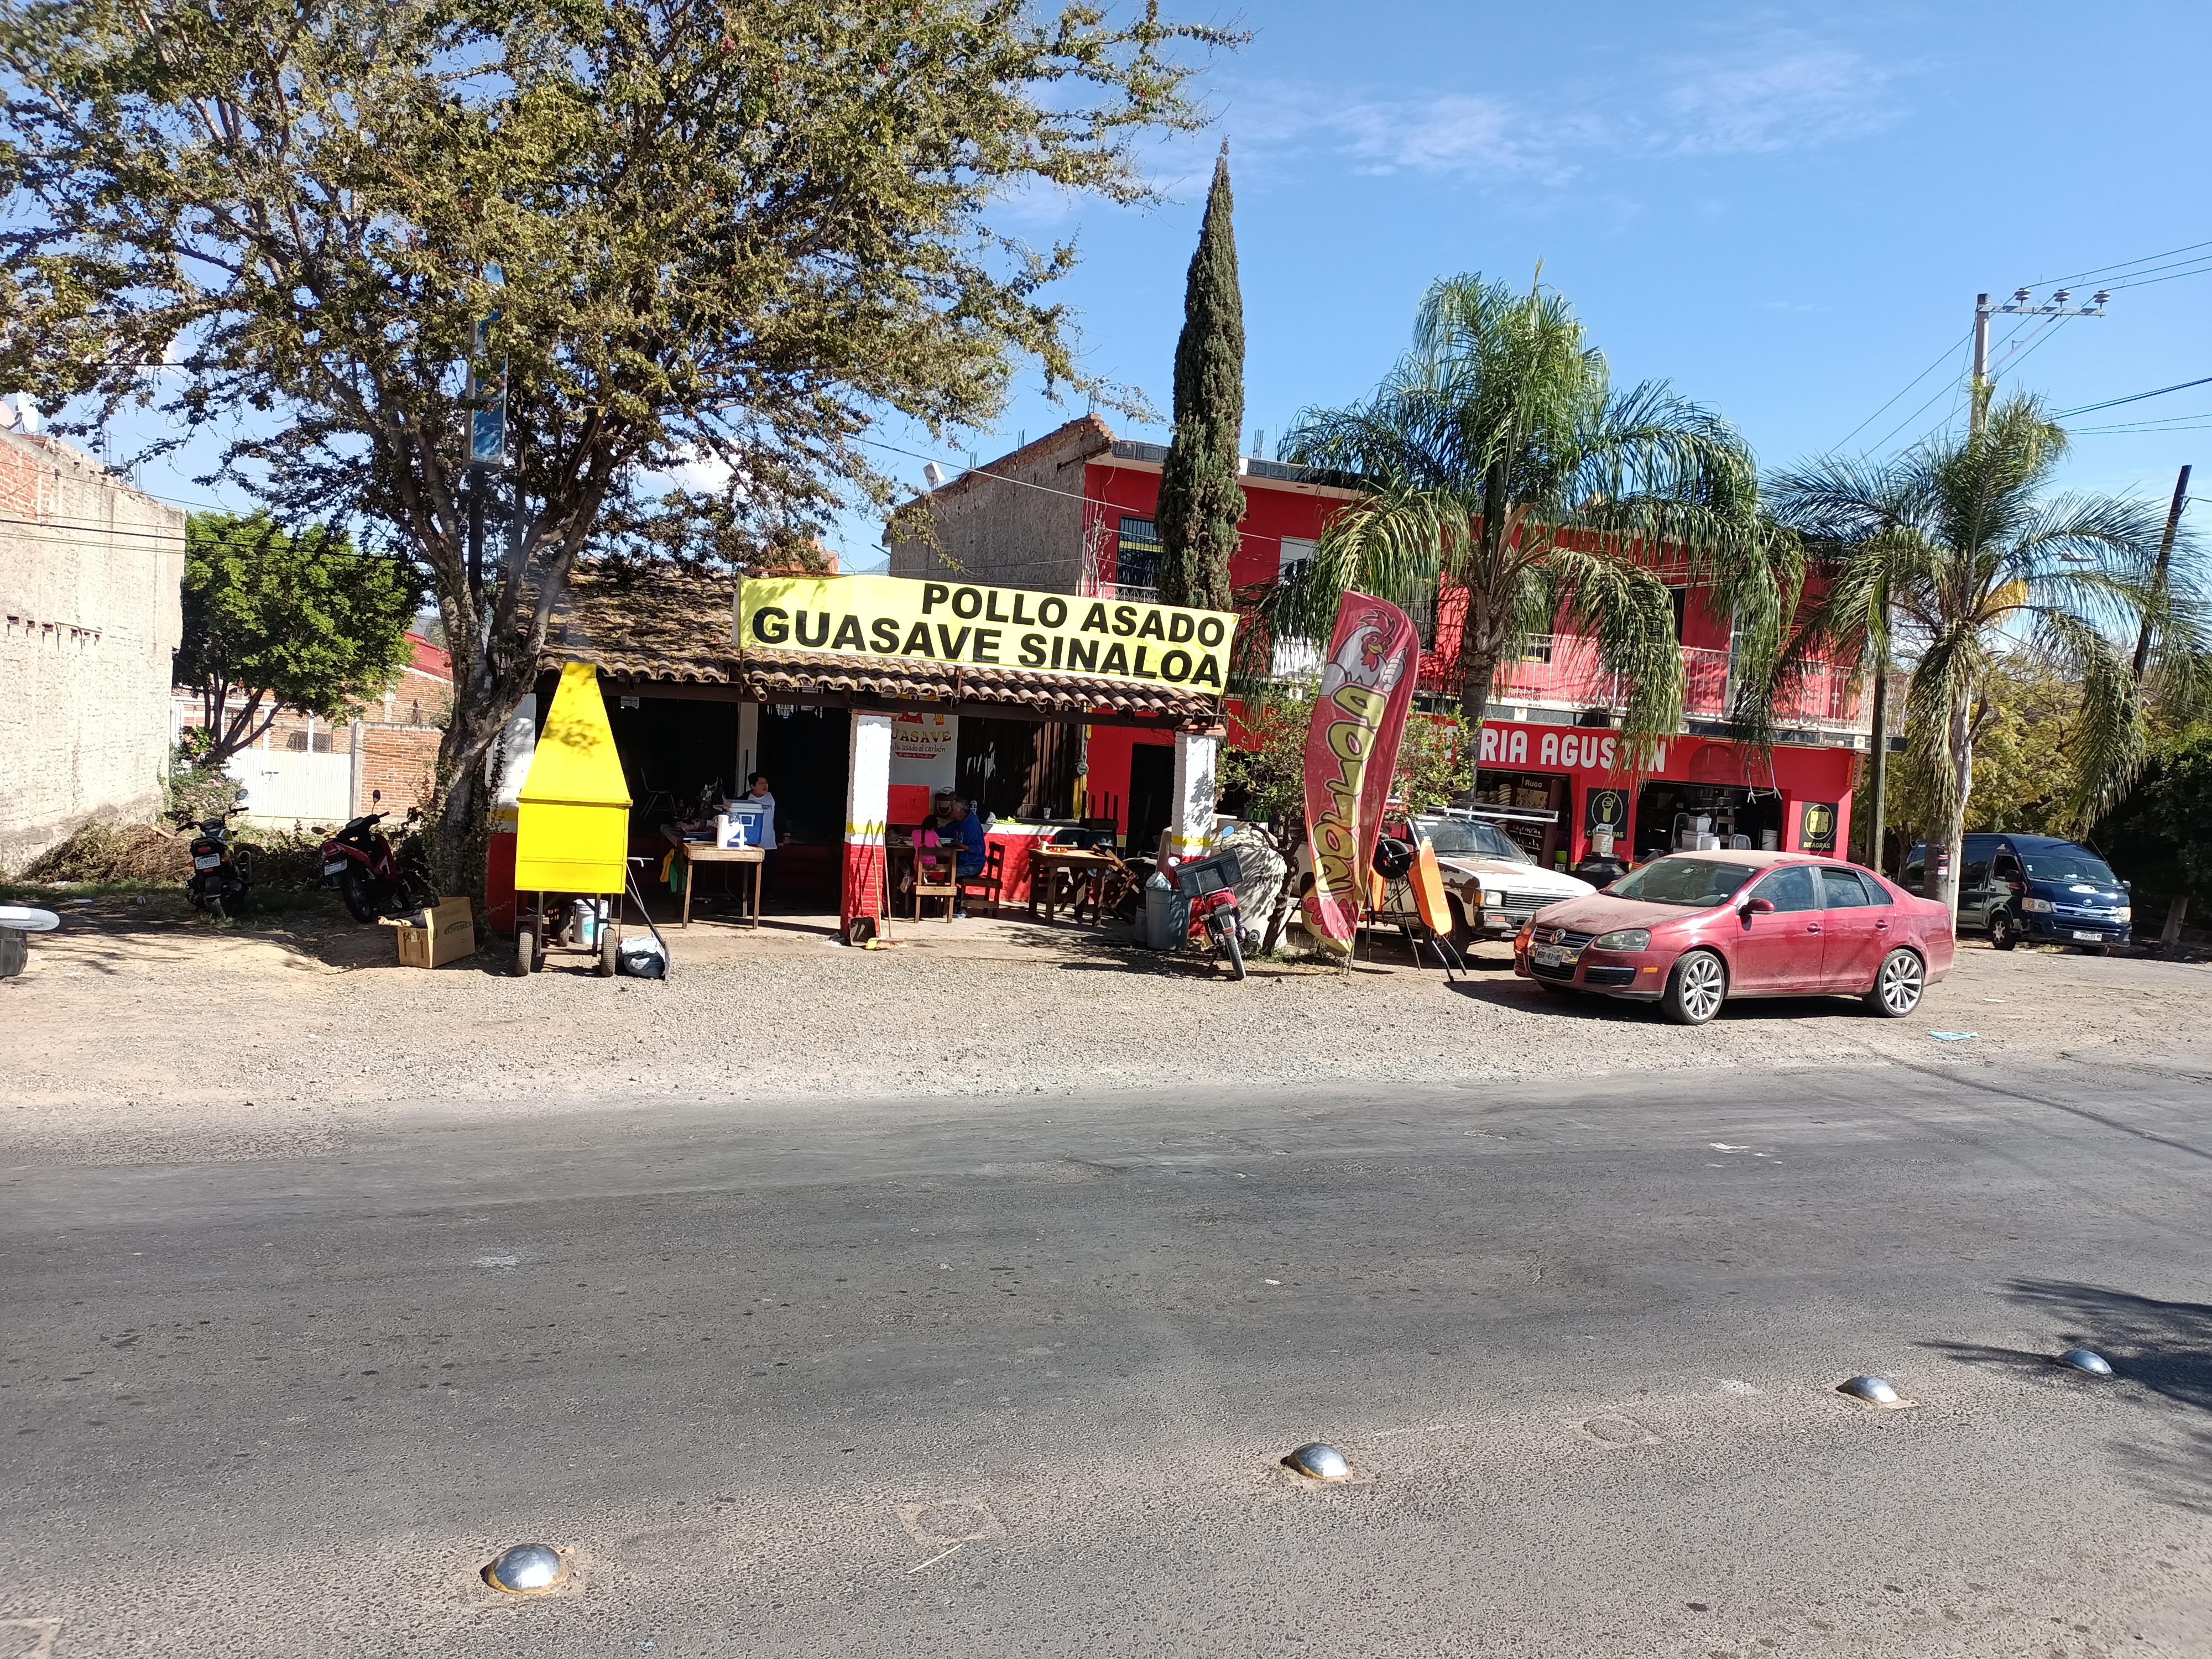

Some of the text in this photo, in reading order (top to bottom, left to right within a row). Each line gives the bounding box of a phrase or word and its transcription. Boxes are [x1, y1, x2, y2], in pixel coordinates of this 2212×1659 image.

[922, 582, 1225, 648] POLLO ASADO
[752, 606, 1222, 688] GUASAVE SINALOA
[891, 728, 952, 743] UASAVE
[925, 744, 946, 753] carbón
[1411, 880, 1420, 902] TRUPER
